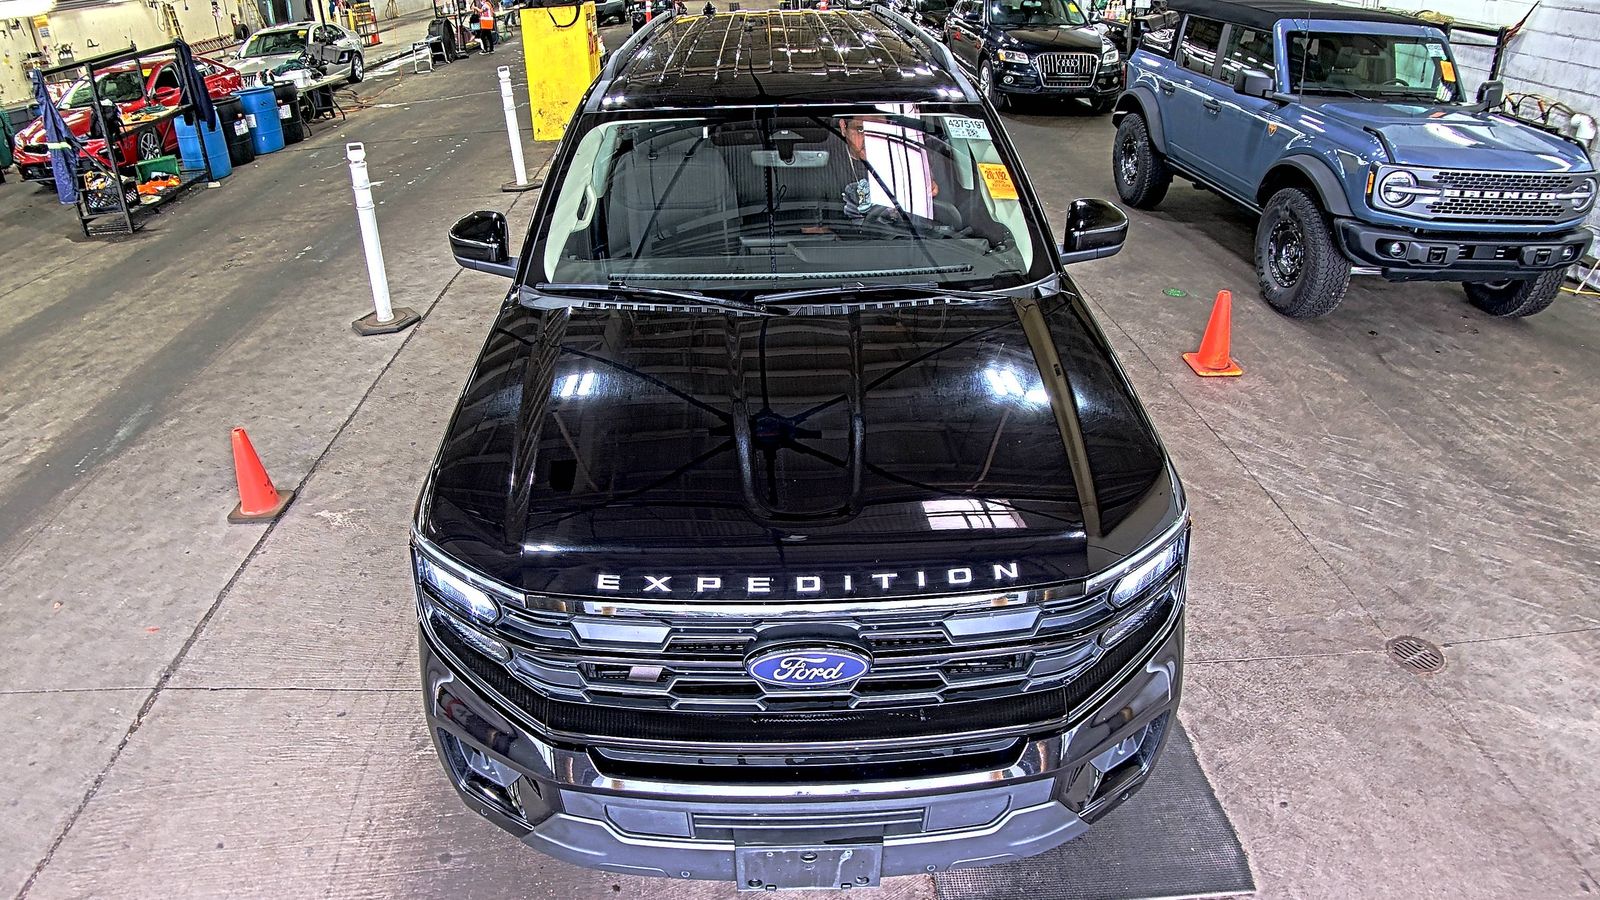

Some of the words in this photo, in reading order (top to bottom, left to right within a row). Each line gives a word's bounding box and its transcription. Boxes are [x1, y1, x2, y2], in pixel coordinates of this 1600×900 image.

[948, 119, 985, 129] 4375197
[1443, 189, 1557, 200] BRONCO
[597, 562, 1019, 592] EXPEDITION
[773, 657, 844, 681] Ford
